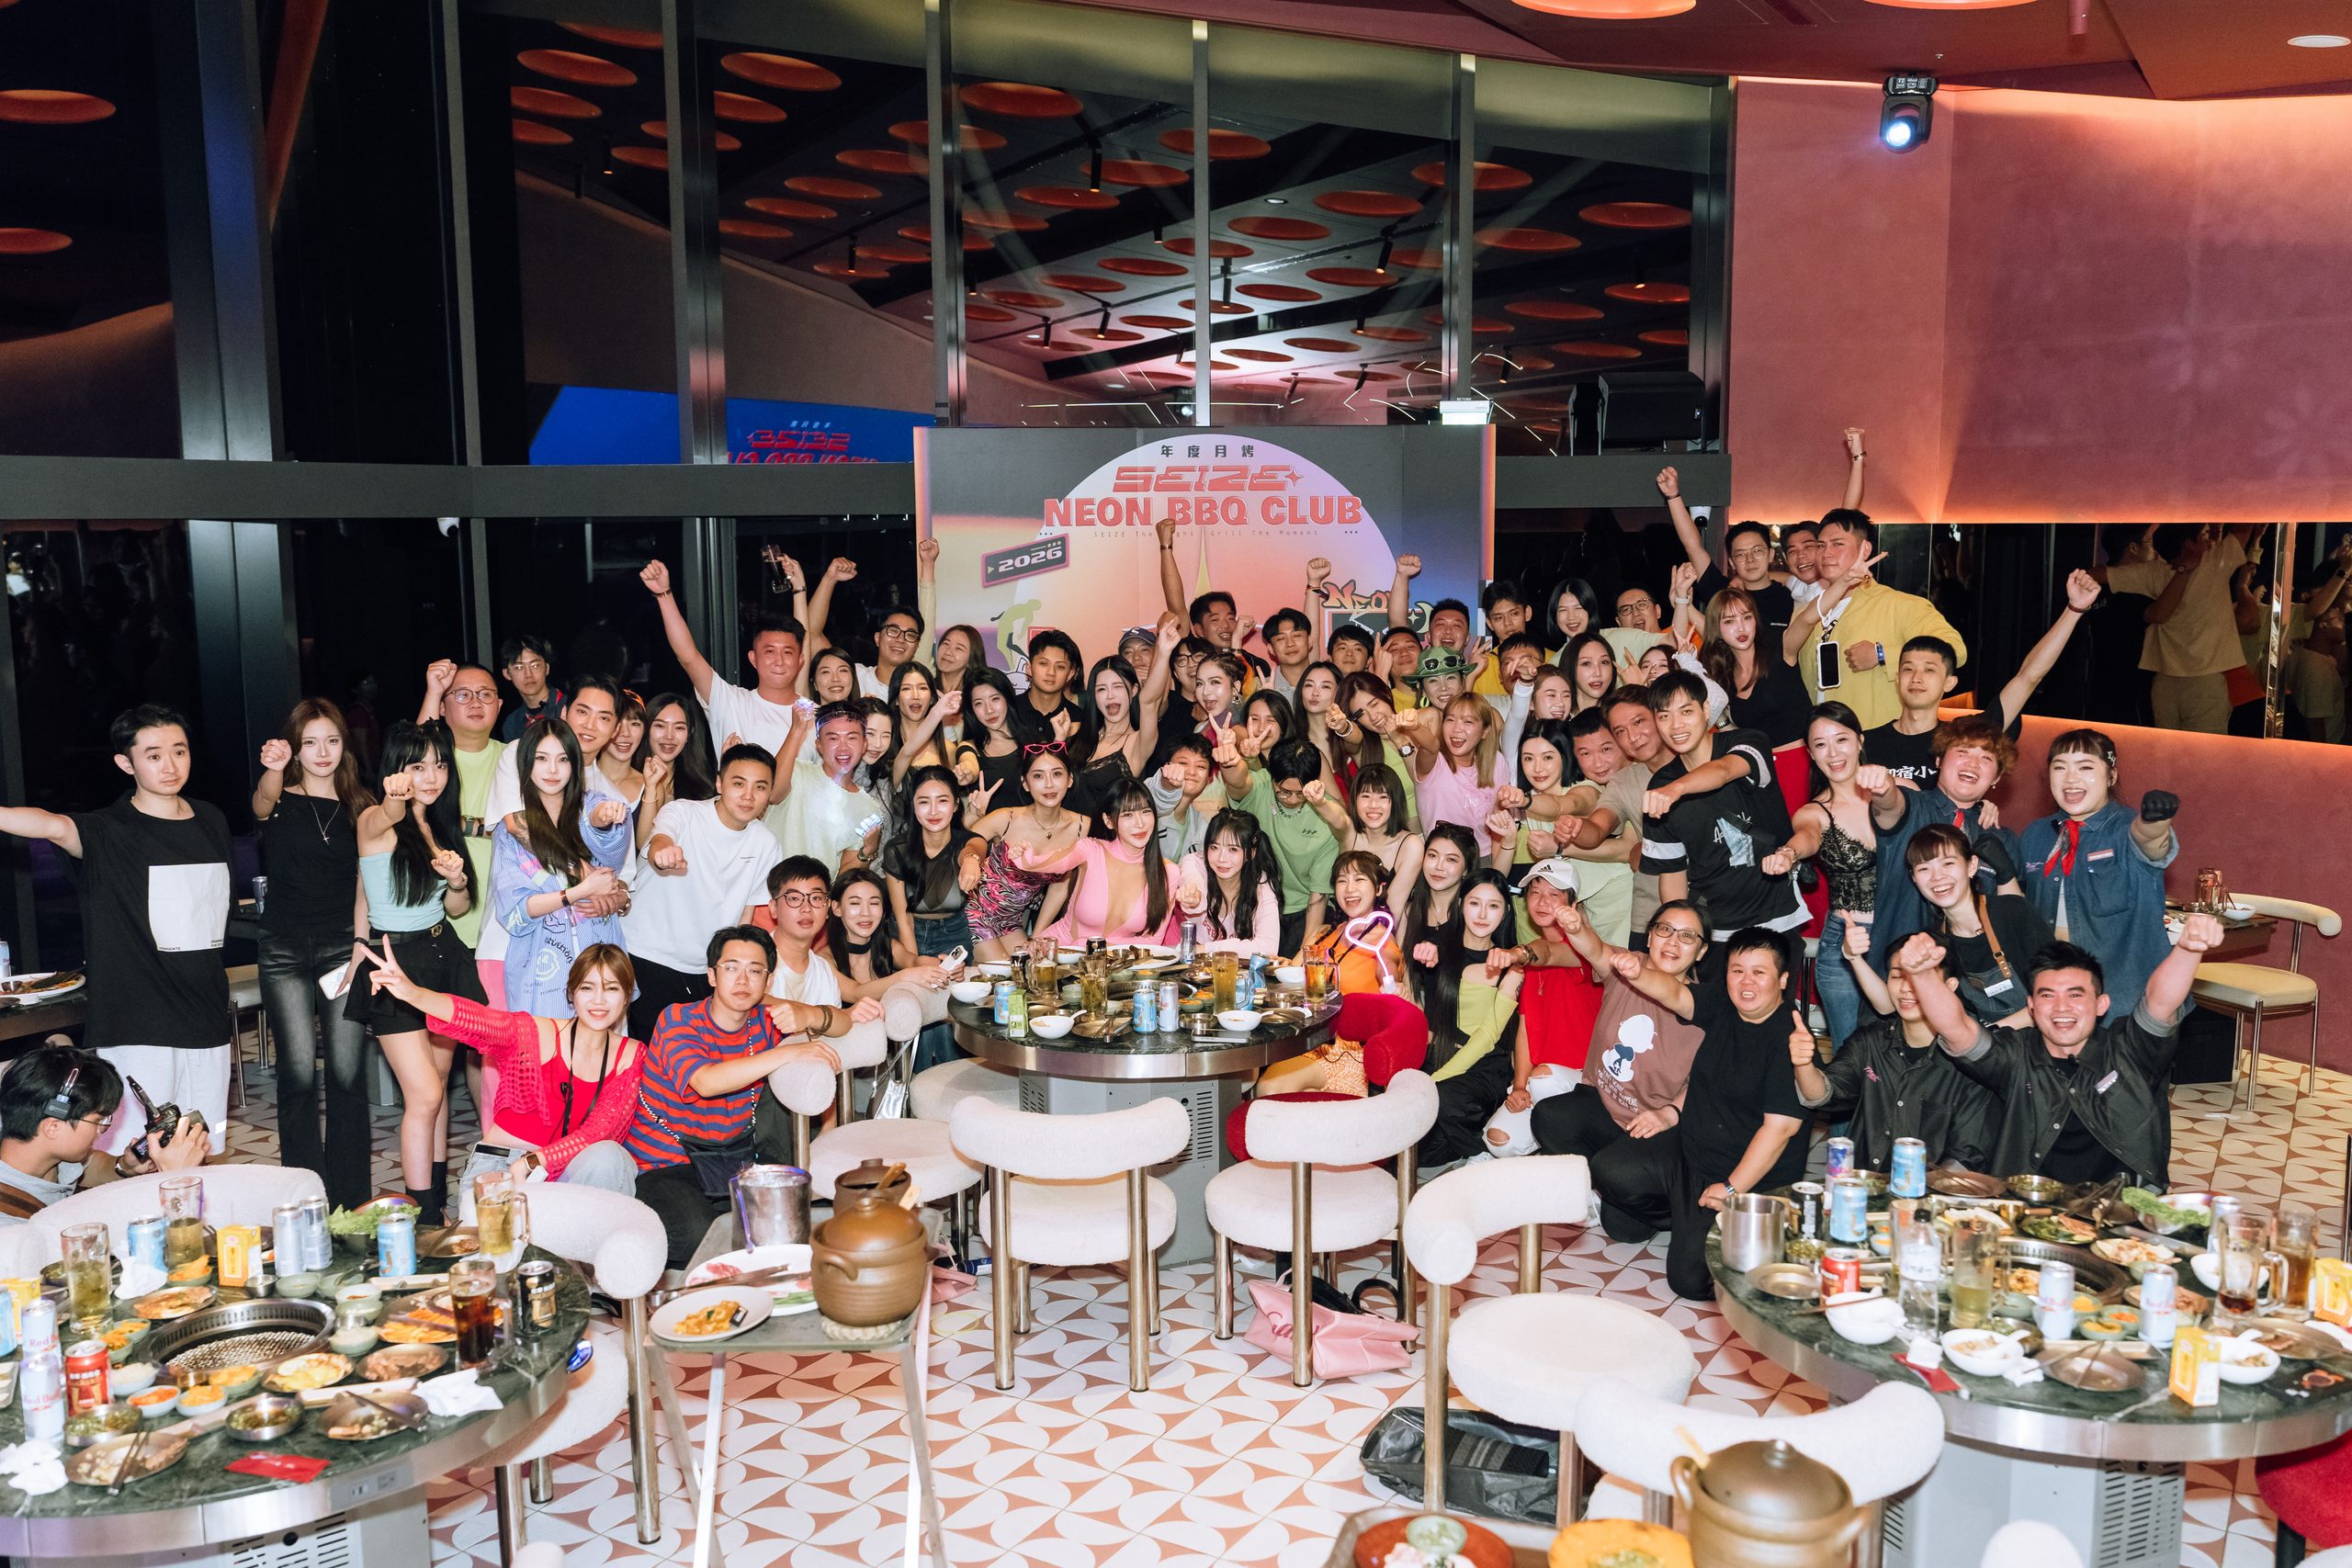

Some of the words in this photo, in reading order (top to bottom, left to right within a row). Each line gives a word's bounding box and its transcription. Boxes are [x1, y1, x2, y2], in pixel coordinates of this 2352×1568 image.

[1161, 445, 1255, 458] 年度月烤
[1113, 465, 1291, 492] SEIZE
[1045, 497, 1152, 526] NEON
[1168, 496, 1249, 526] BBQ
[1261, 495, 1363, 525] CLUB
[999, 547, 1062, 572] 2026
[1322, 579, 1391, 609] NEO
